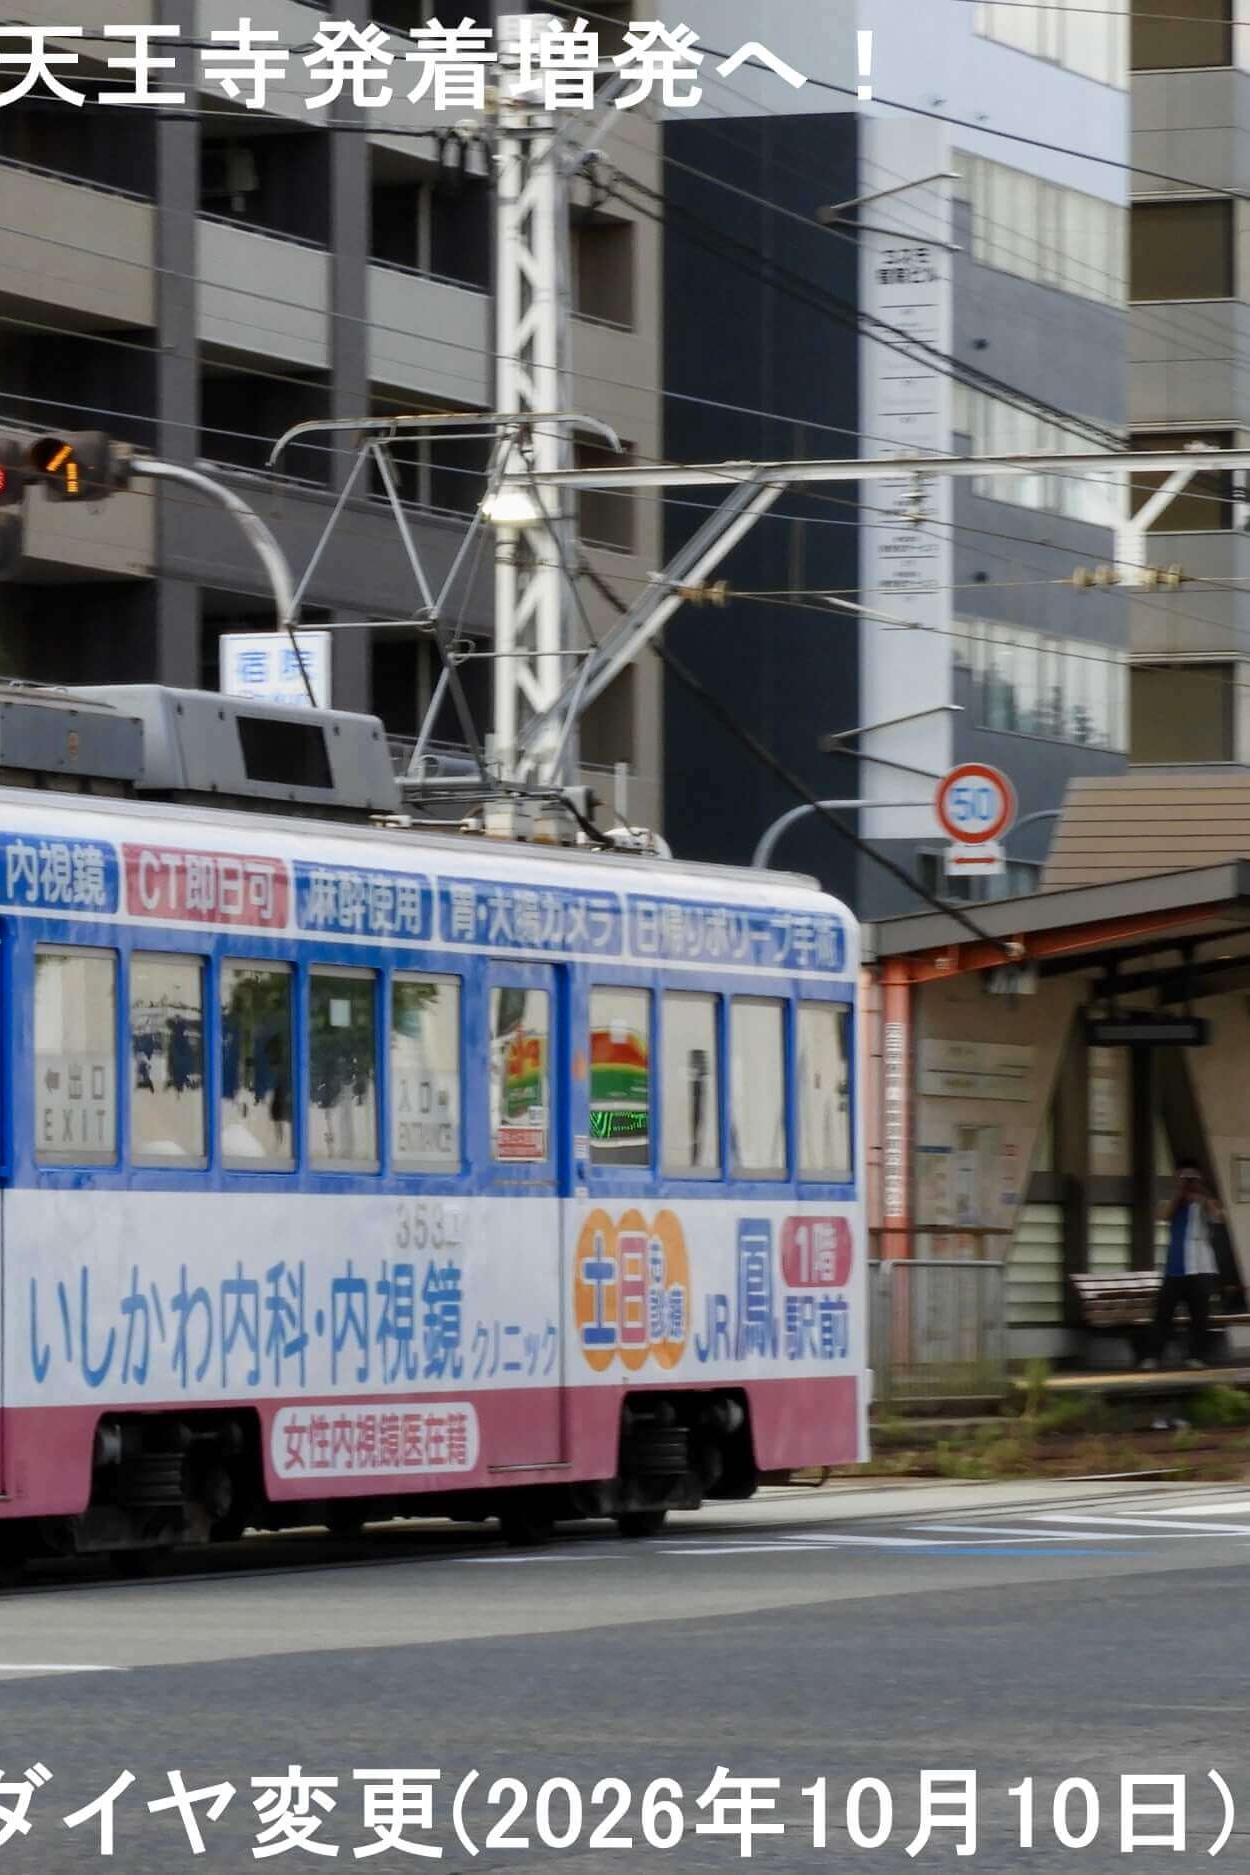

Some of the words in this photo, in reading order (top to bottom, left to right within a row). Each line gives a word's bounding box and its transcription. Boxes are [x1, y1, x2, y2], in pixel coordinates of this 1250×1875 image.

[948, 787, 993, 821] 50
[138, 848, 276, 921] CT即日可
[303, 868, 423, 936] 麻酔使用
[634, 902, 840, 968] 日帰りポリープ手術
[68, 1063, 105, 1101] 出口
[398, 1079, 431, 1113] 入口
[45, 1108, 107, 1142] EXIT
[396, 1202, 446, 1250] 353
[795, 1223, 837, 1282] 1階
